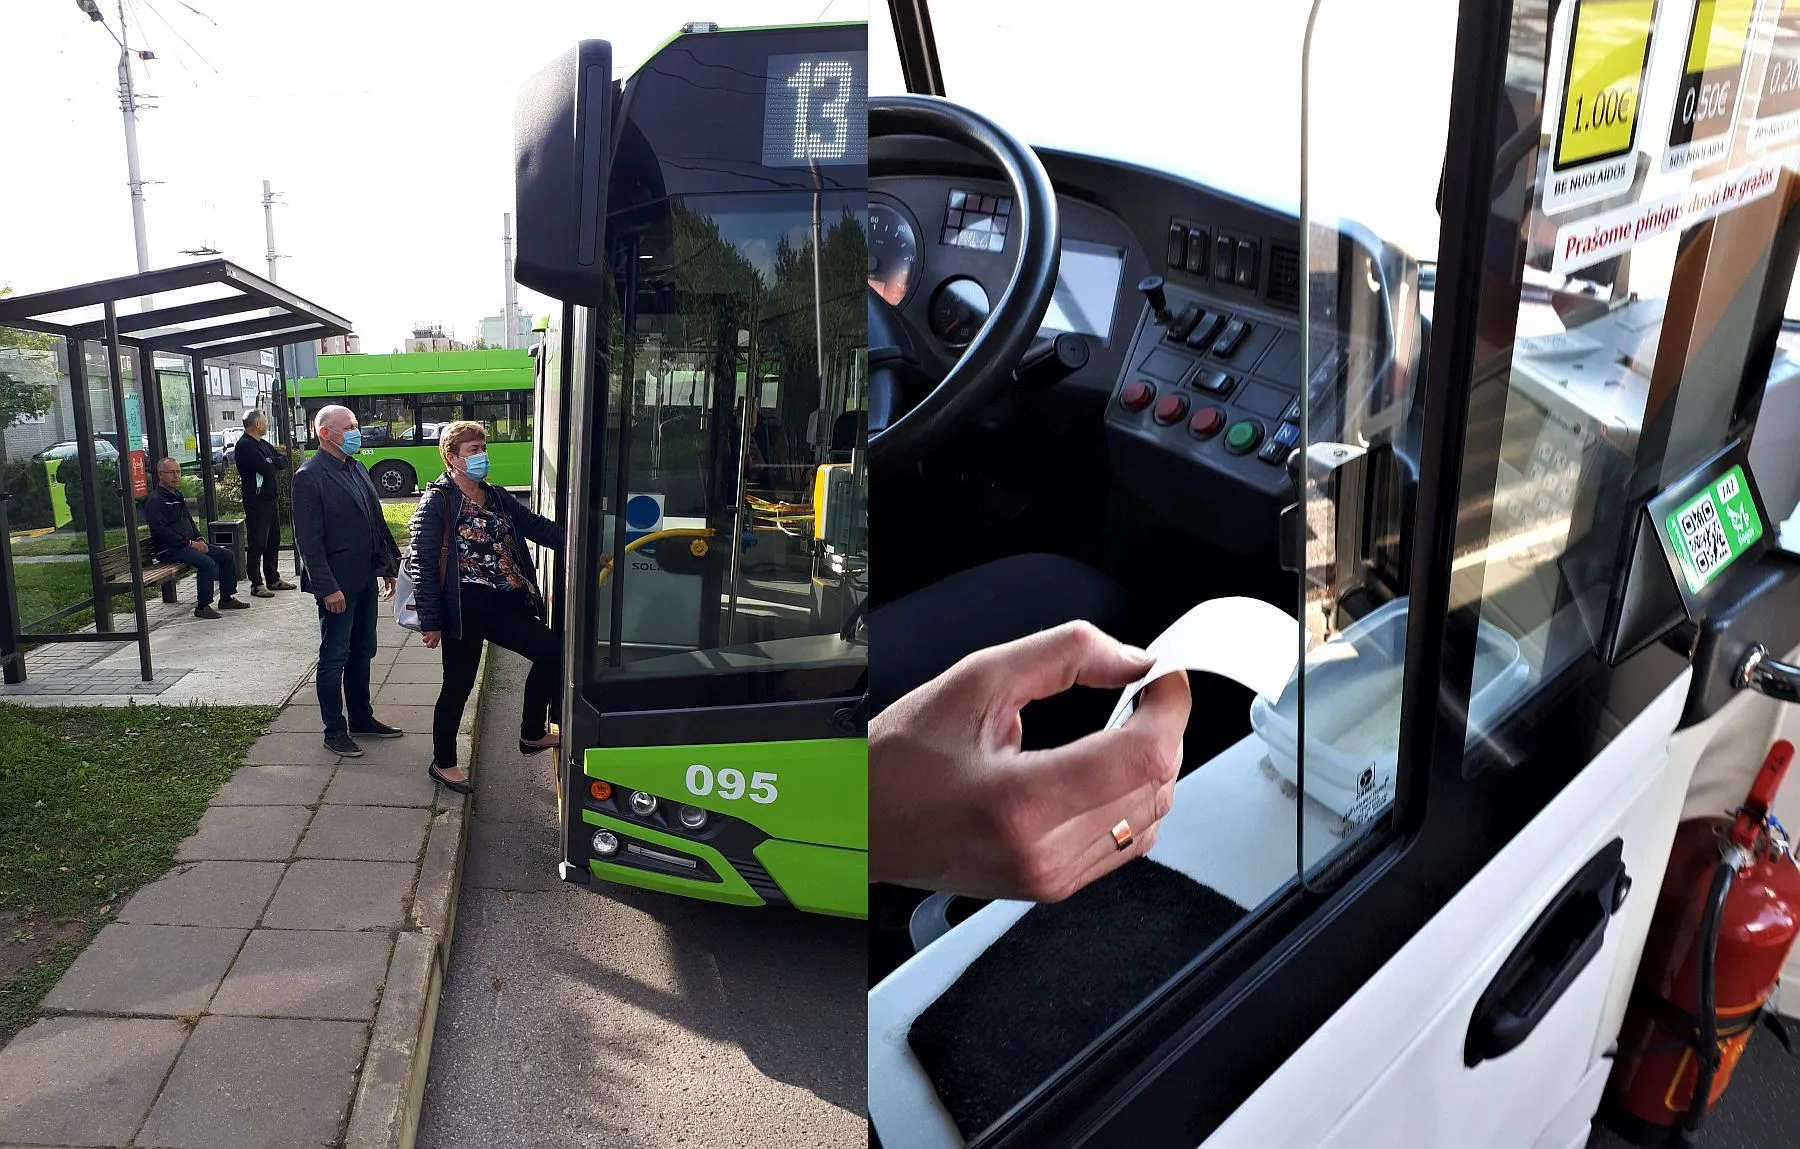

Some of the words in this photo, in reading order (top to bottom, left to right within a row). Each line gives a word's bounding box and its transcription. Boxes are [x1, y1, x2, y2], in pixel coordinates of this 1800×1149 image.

[1769, 59, 1800, 95] 0.20
[787, 61, 852, 158] 13
[1572, 87, 1632, 134] 1.00€
[1683, 80, 1730, 125] 0.50€
[1554, 179, 1567, 196] BE
[1570, 162, 1626, 192] NUOLAIDOS
[1565, 221, 1632, 262] Prašome
[1634, 202, 1685, 242] pinigus
[1723, 180, 1737, 202] be
[631, 562, 661, 571] SOL
[685, 764, 778, 804] 095
